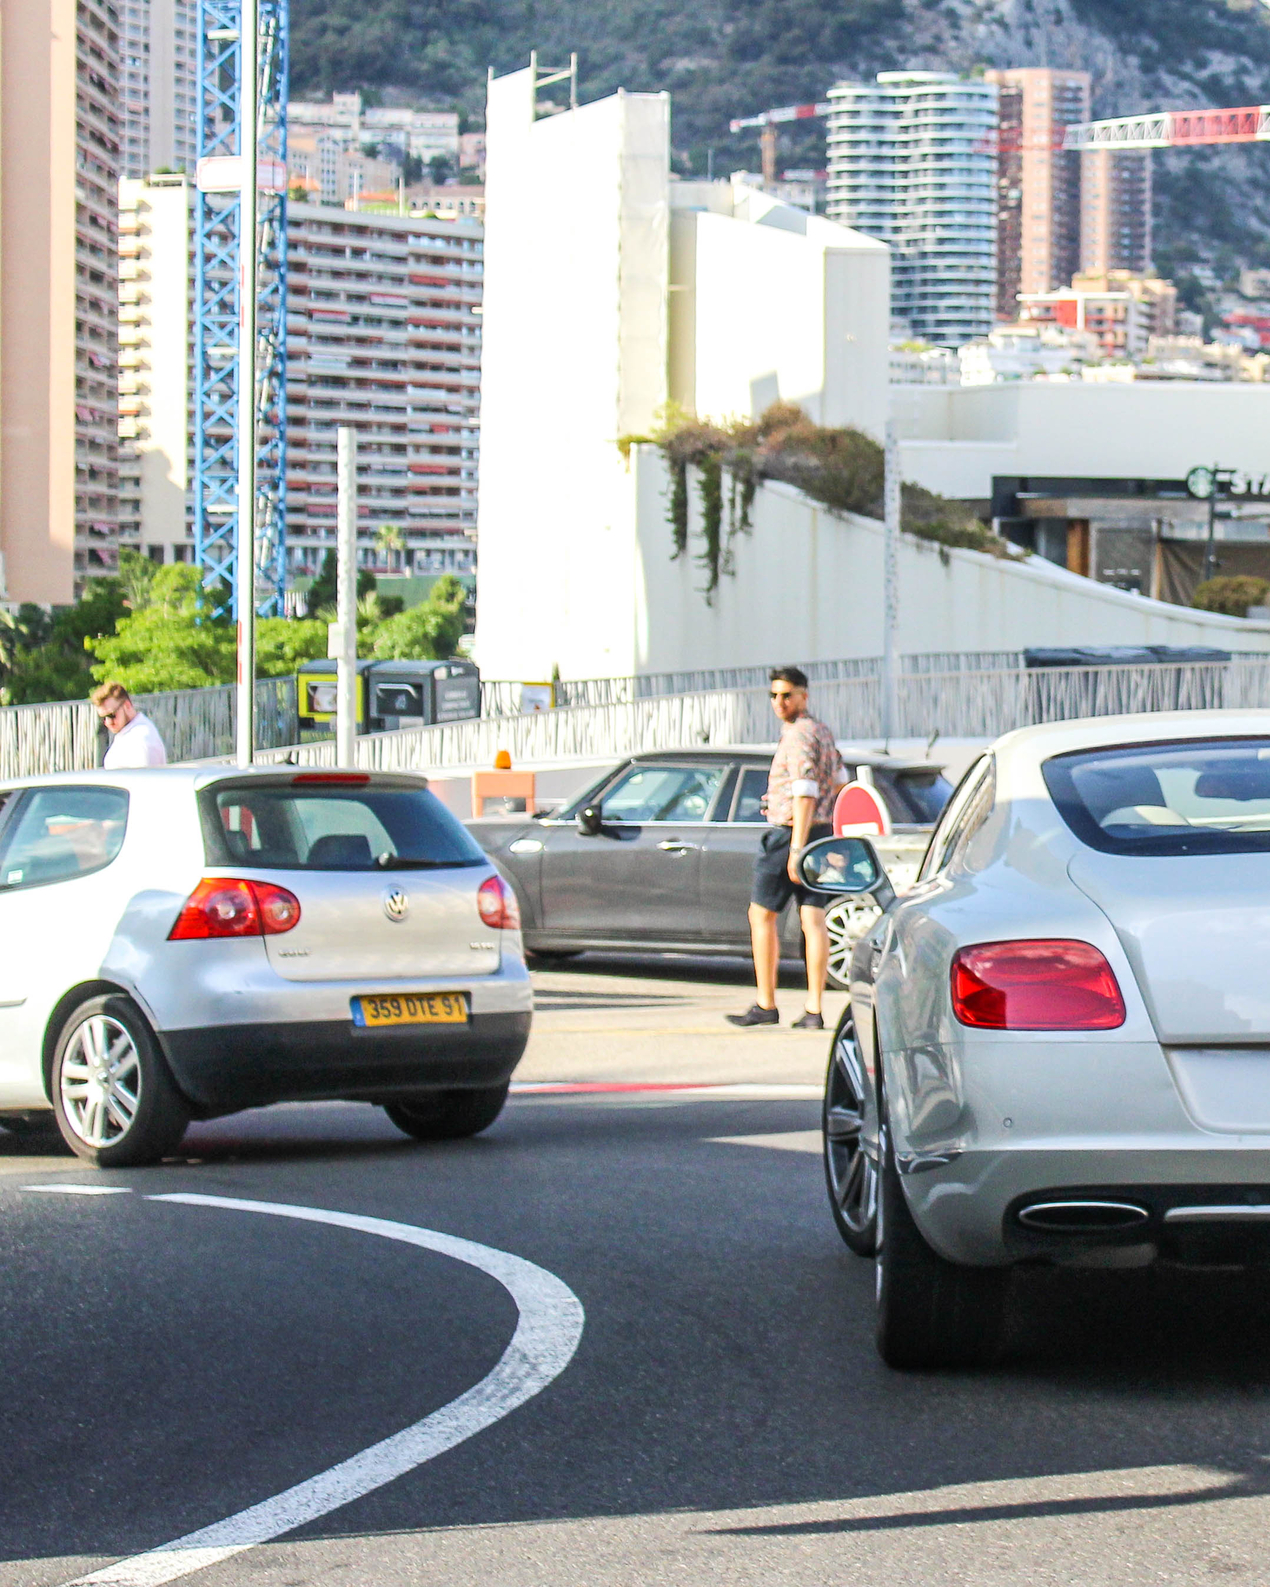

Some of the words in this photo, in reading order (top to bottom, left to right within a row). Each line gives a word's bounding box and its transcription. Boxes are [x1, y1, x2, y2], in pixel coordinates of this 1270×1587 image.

[368, 998, 402, 1019] 359
[405, 996, 438, 1016] DTE
[441, 994, 463, 1015] 91
